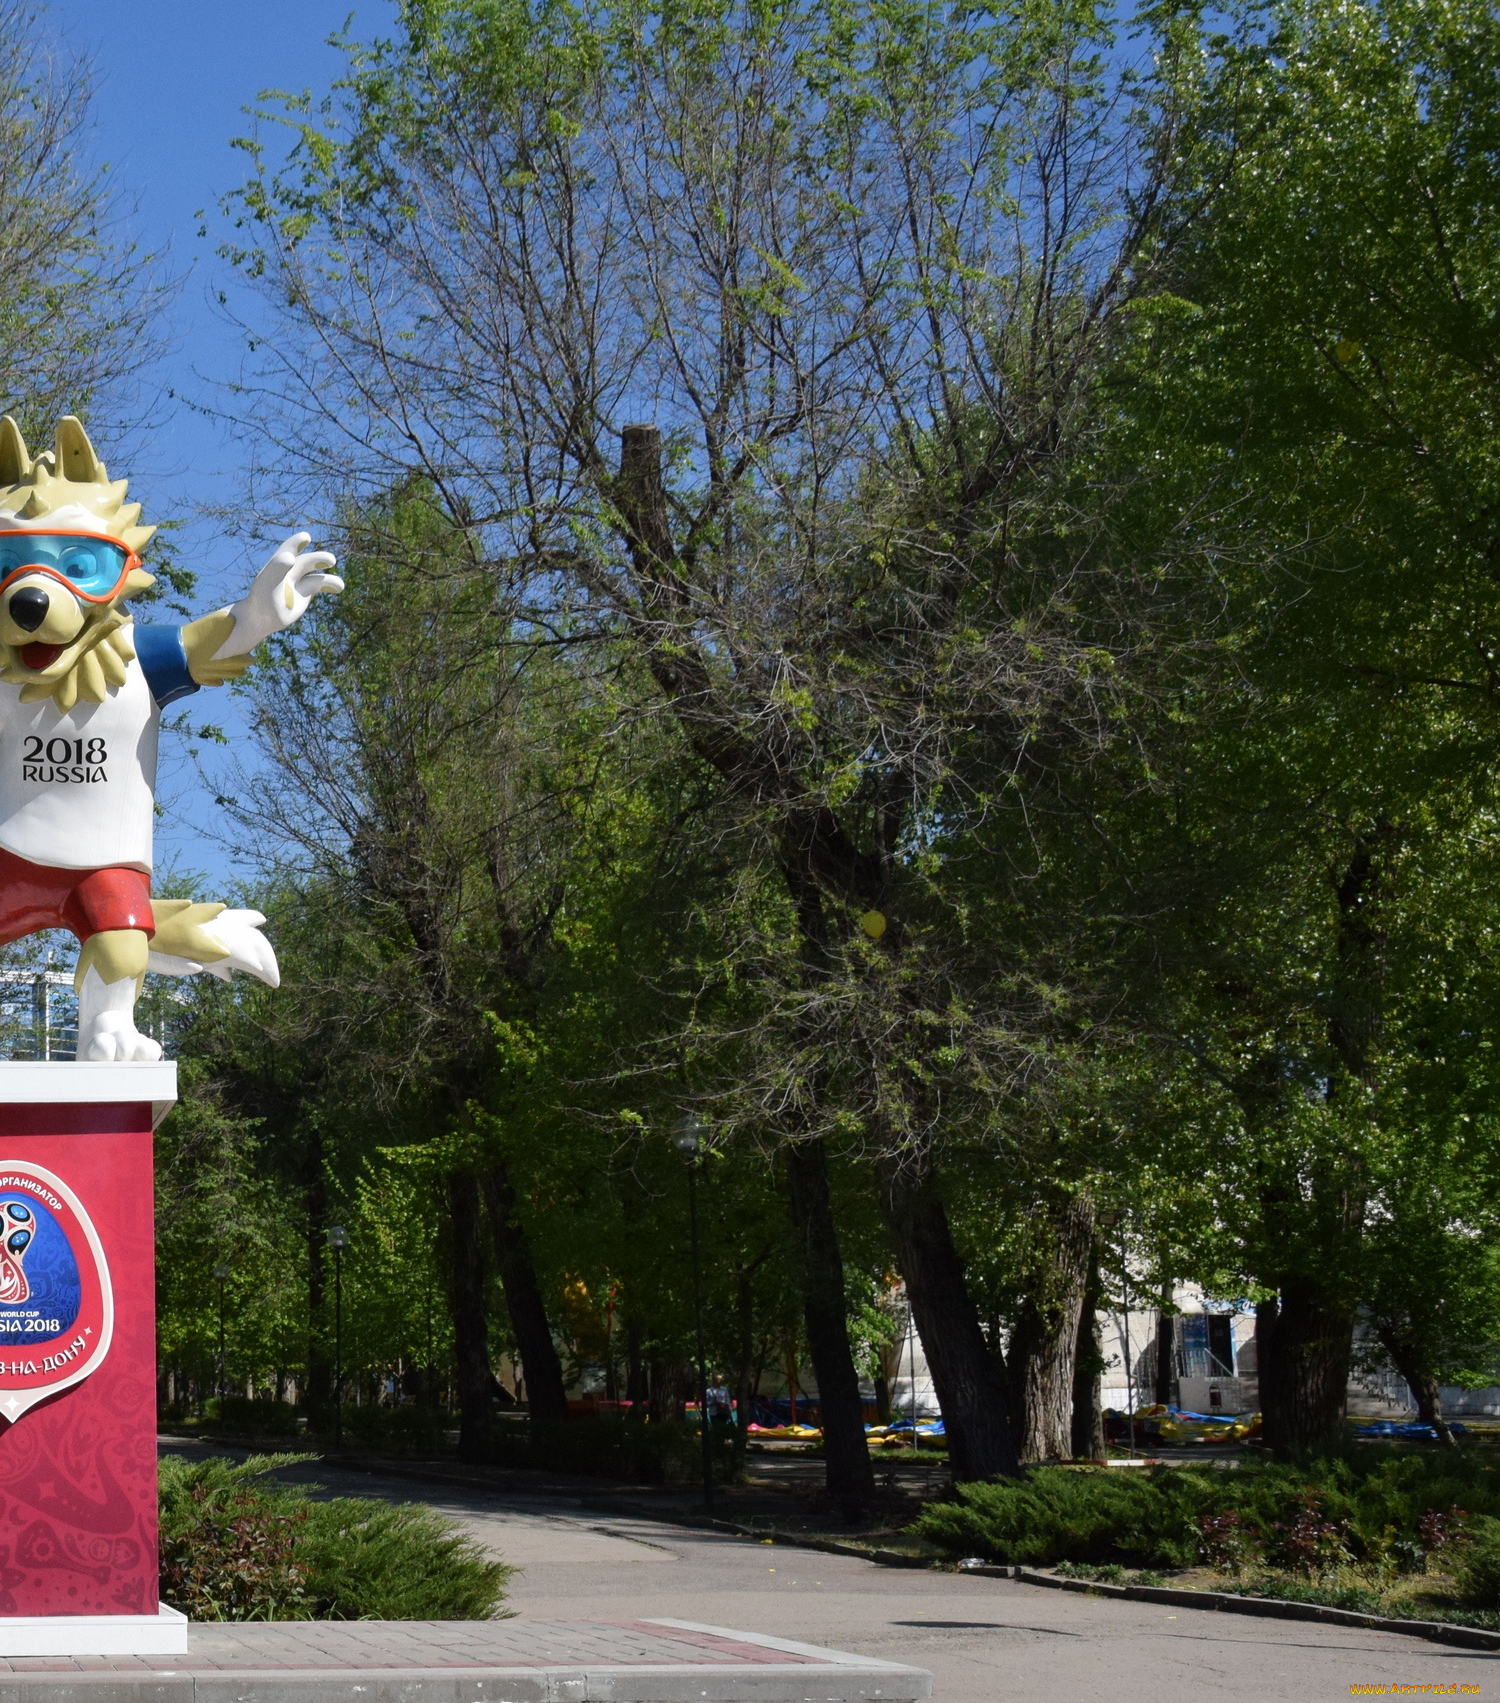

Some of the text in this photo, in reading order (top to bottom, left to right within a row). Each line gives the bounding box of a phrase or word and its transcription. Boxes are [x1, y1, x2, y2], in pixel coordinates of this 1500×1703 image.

[22, 735, 108, 765] 2018
[22, 765, 108, 784] RUSSIA
[24, 1319, 60, 1332] 2018
